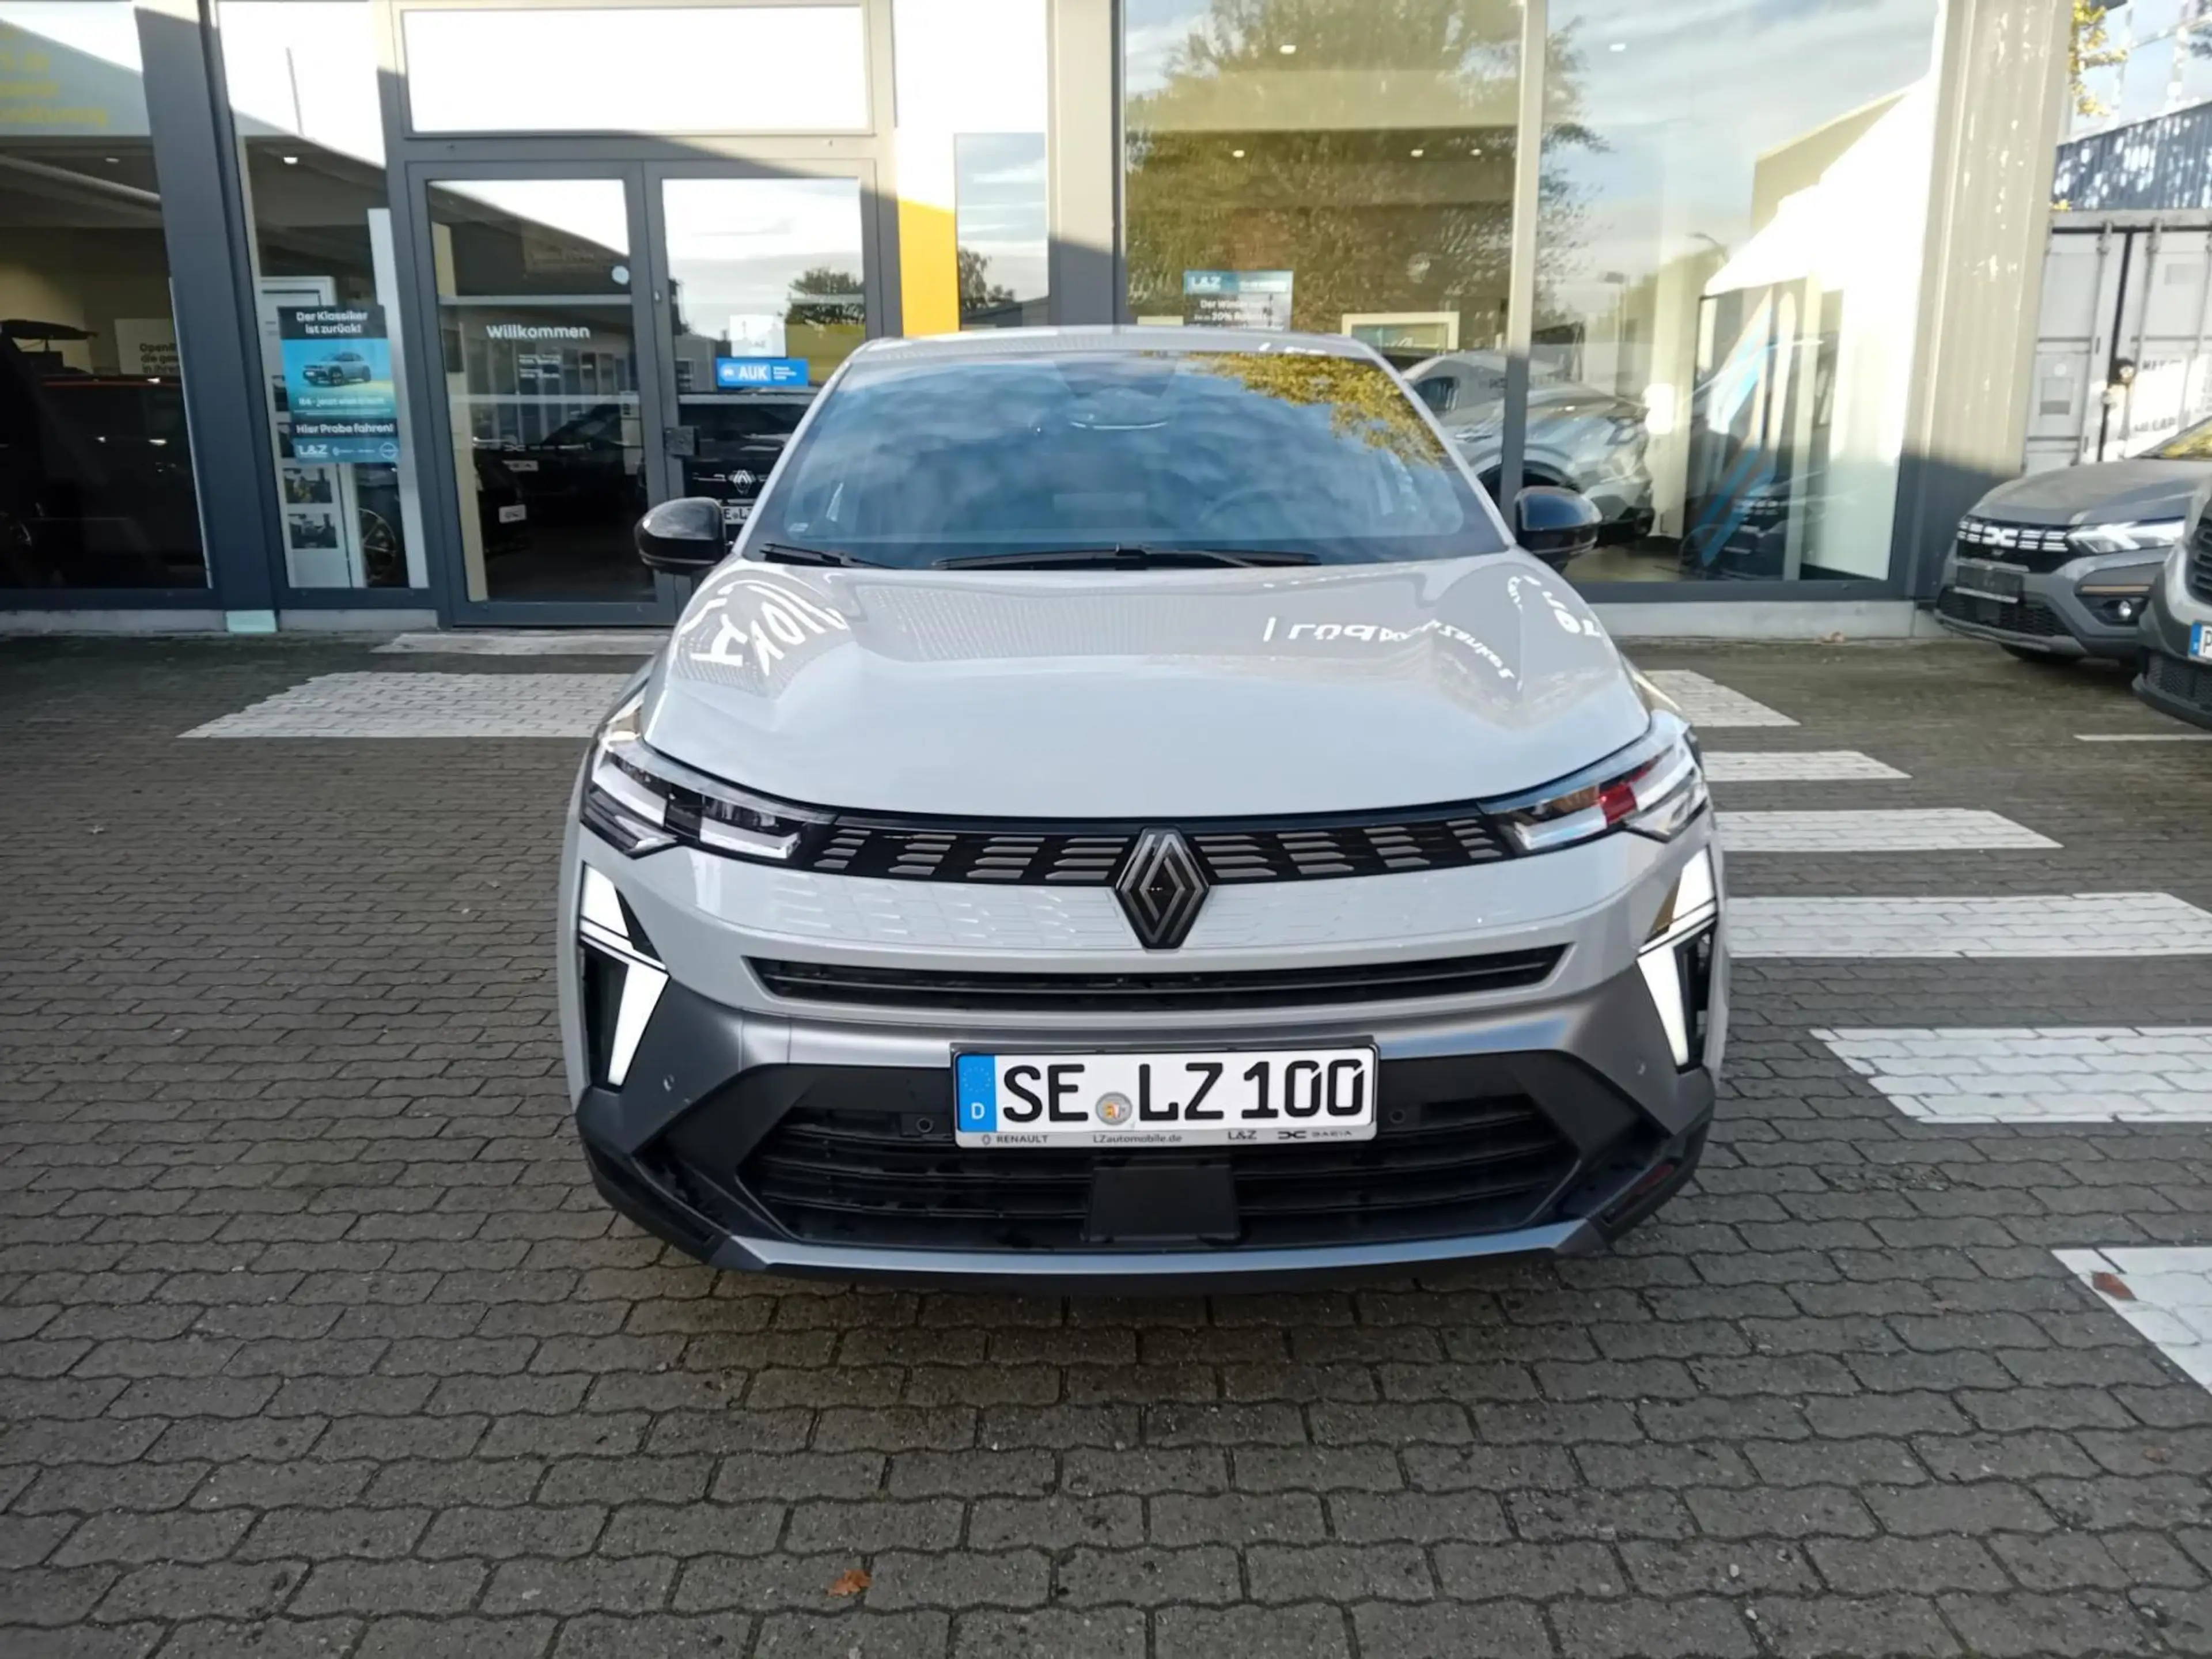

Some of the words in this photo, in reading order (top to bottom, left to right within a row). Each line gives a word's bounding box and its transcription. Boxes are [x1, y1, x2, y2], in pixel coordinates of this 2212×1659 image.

[296, 312, 316, 321] Der
[317, 310, 368, 321] Klassiker
[486, 324, 590, 339] Willkommen
[739, 366, 768, 380] AUK
[296, 423, 319, 434] Hier
[320, 423, 352, 433] Probe
[1003, 1064, 1089, 1123] SE
[1139, 1062, 1224, 1122] LZ
[1241, 1059, 1365, 1119] 100
[971, 1103, 985, 1119] D
[997, 1135, 1048, 1143] RENAULT
[1093, 1134, 1182, 1144] LZautomobile.de
[1228, 1130, 1257, 1141] L&Z
